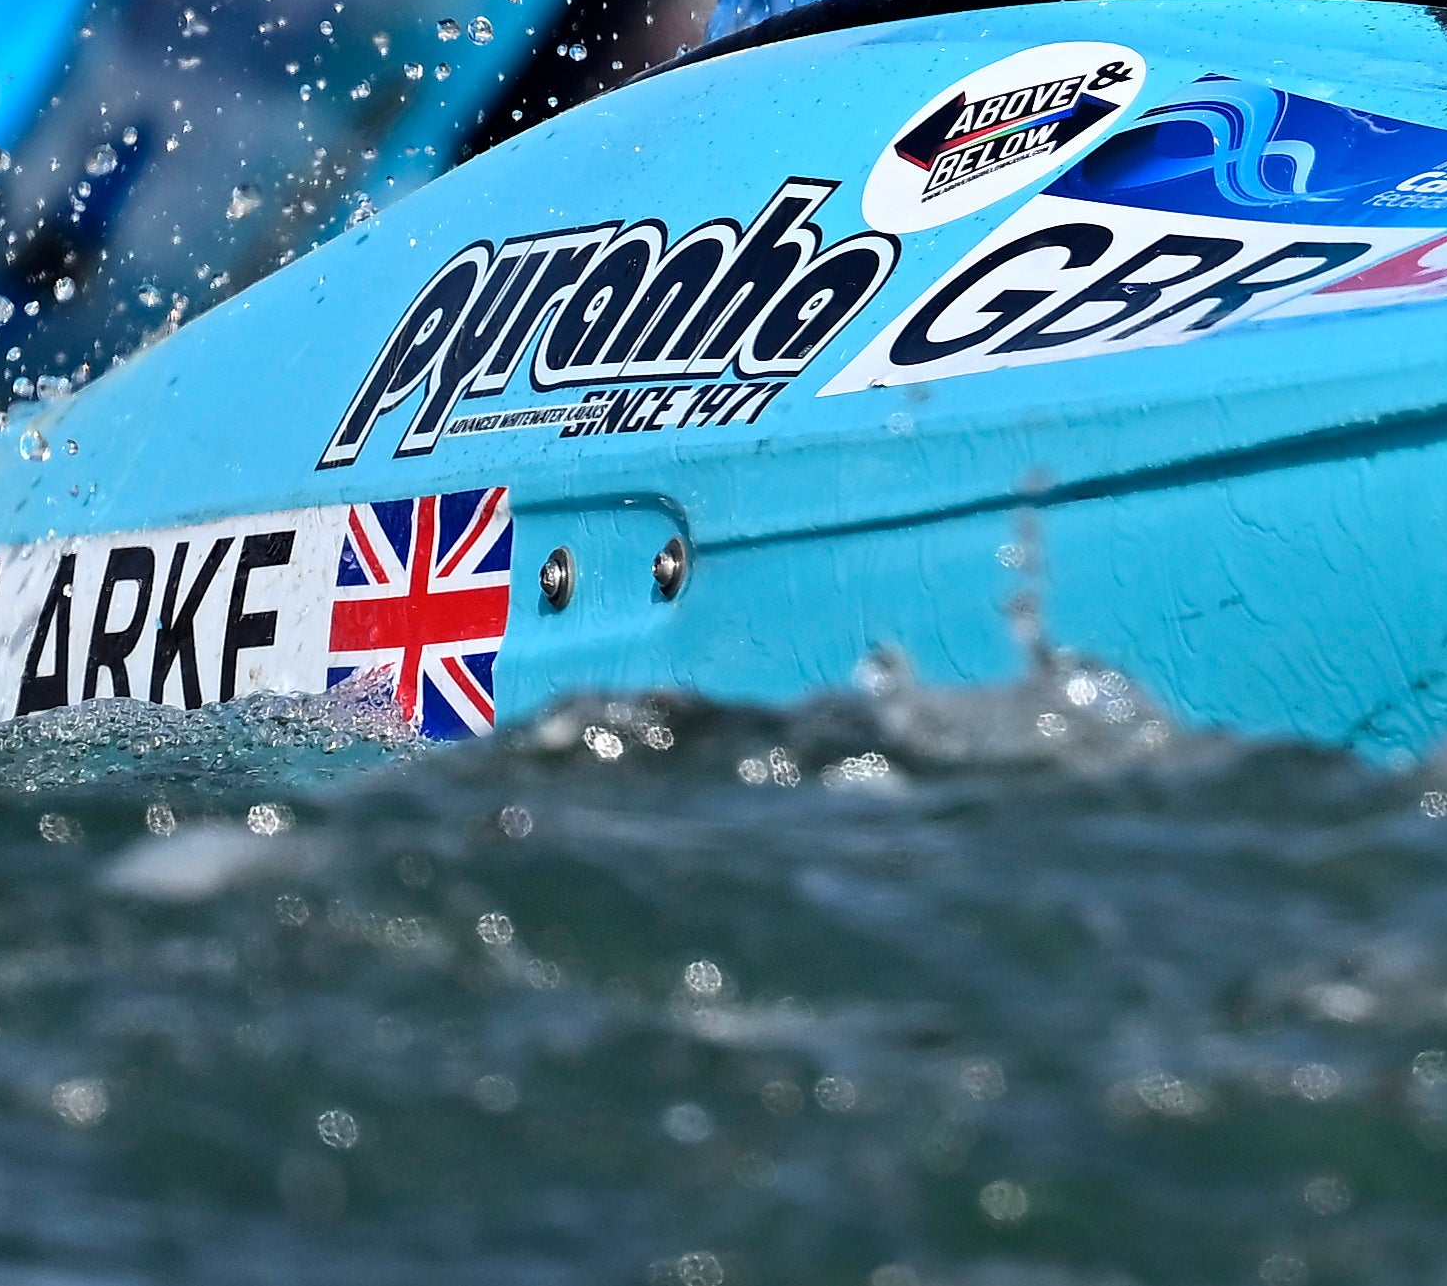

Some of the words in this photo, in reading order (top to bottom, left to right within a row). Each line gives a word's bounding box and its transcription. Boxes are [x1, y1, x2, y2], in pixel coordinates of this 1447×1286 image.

[943, 76, 1084, 141] ABOVE
[1086, 60, 1134, 91] &
[925, 121, 1061, 192] BELOW
[315, 175, 903, 471] pyranha
[887, 222, 1373, 367] GBR
[558, 385, 694, 439] SINCE
[676, 381, 791, 429] 1971
